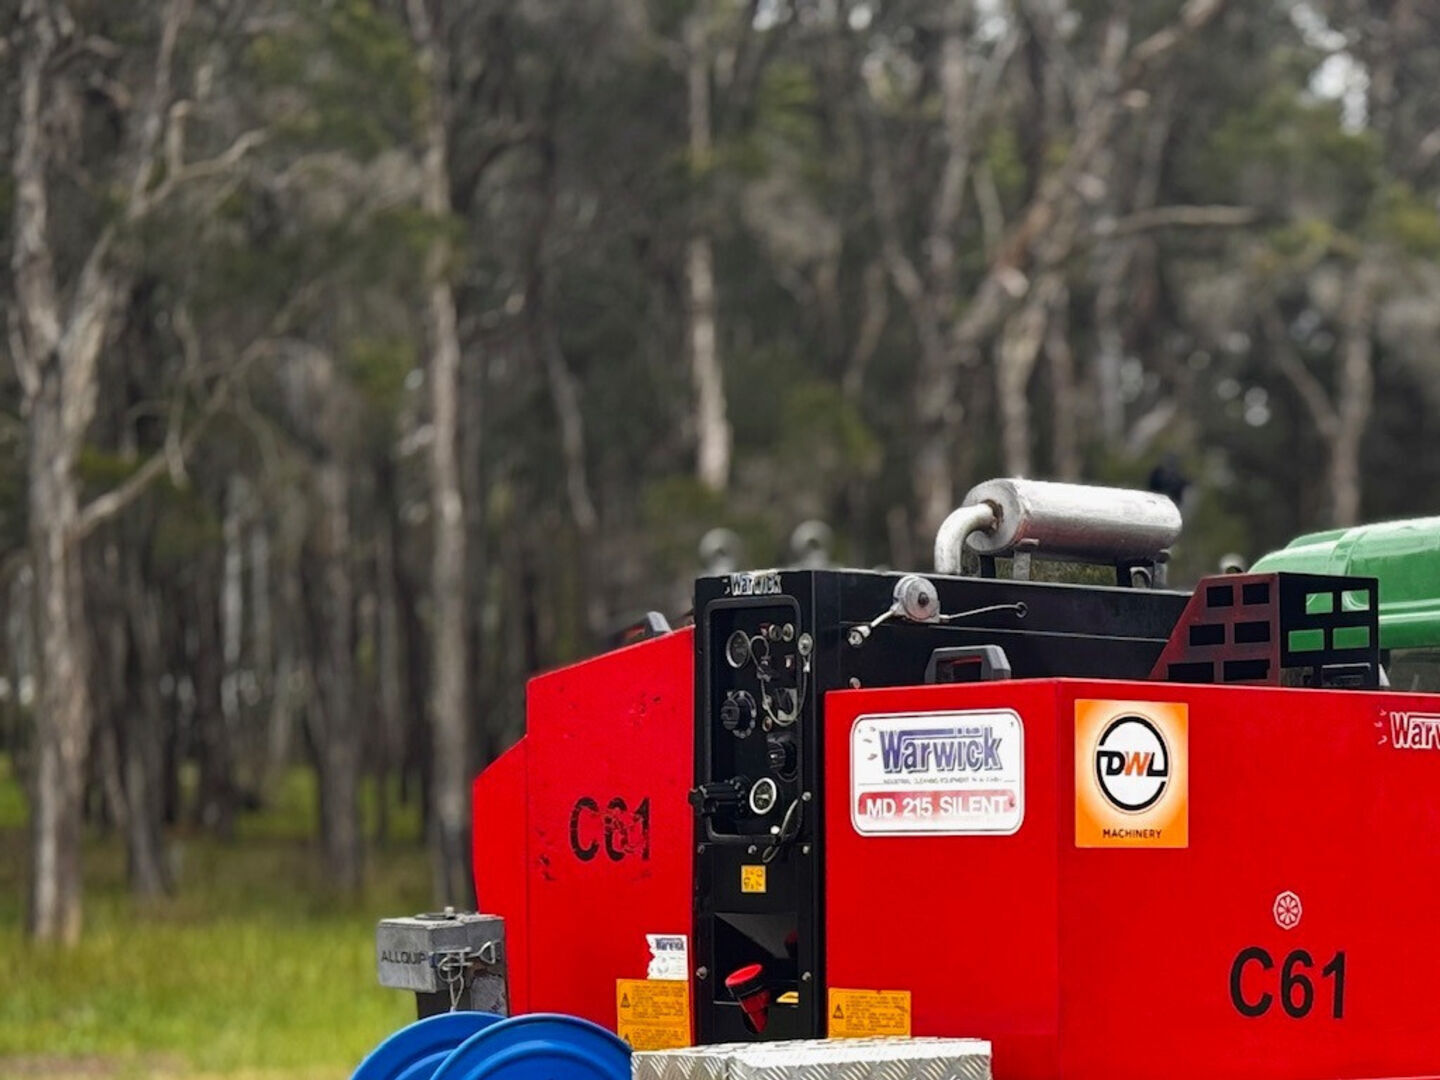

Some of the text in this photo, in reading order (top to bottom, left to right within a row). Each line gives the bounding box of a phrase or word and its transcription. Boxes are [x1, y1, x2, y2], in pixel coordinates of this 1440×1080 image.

[879, 726, 1003, 774] Warwick
[1097, 751, 1169, 777] DWL
[865, 796, 1010, 819] MD 215 SILENT
[569, 796, 651, 862] C61
[1102, 828, 1162, 839] MACHINERY
[1229, 946, 1346, 1019] C61
